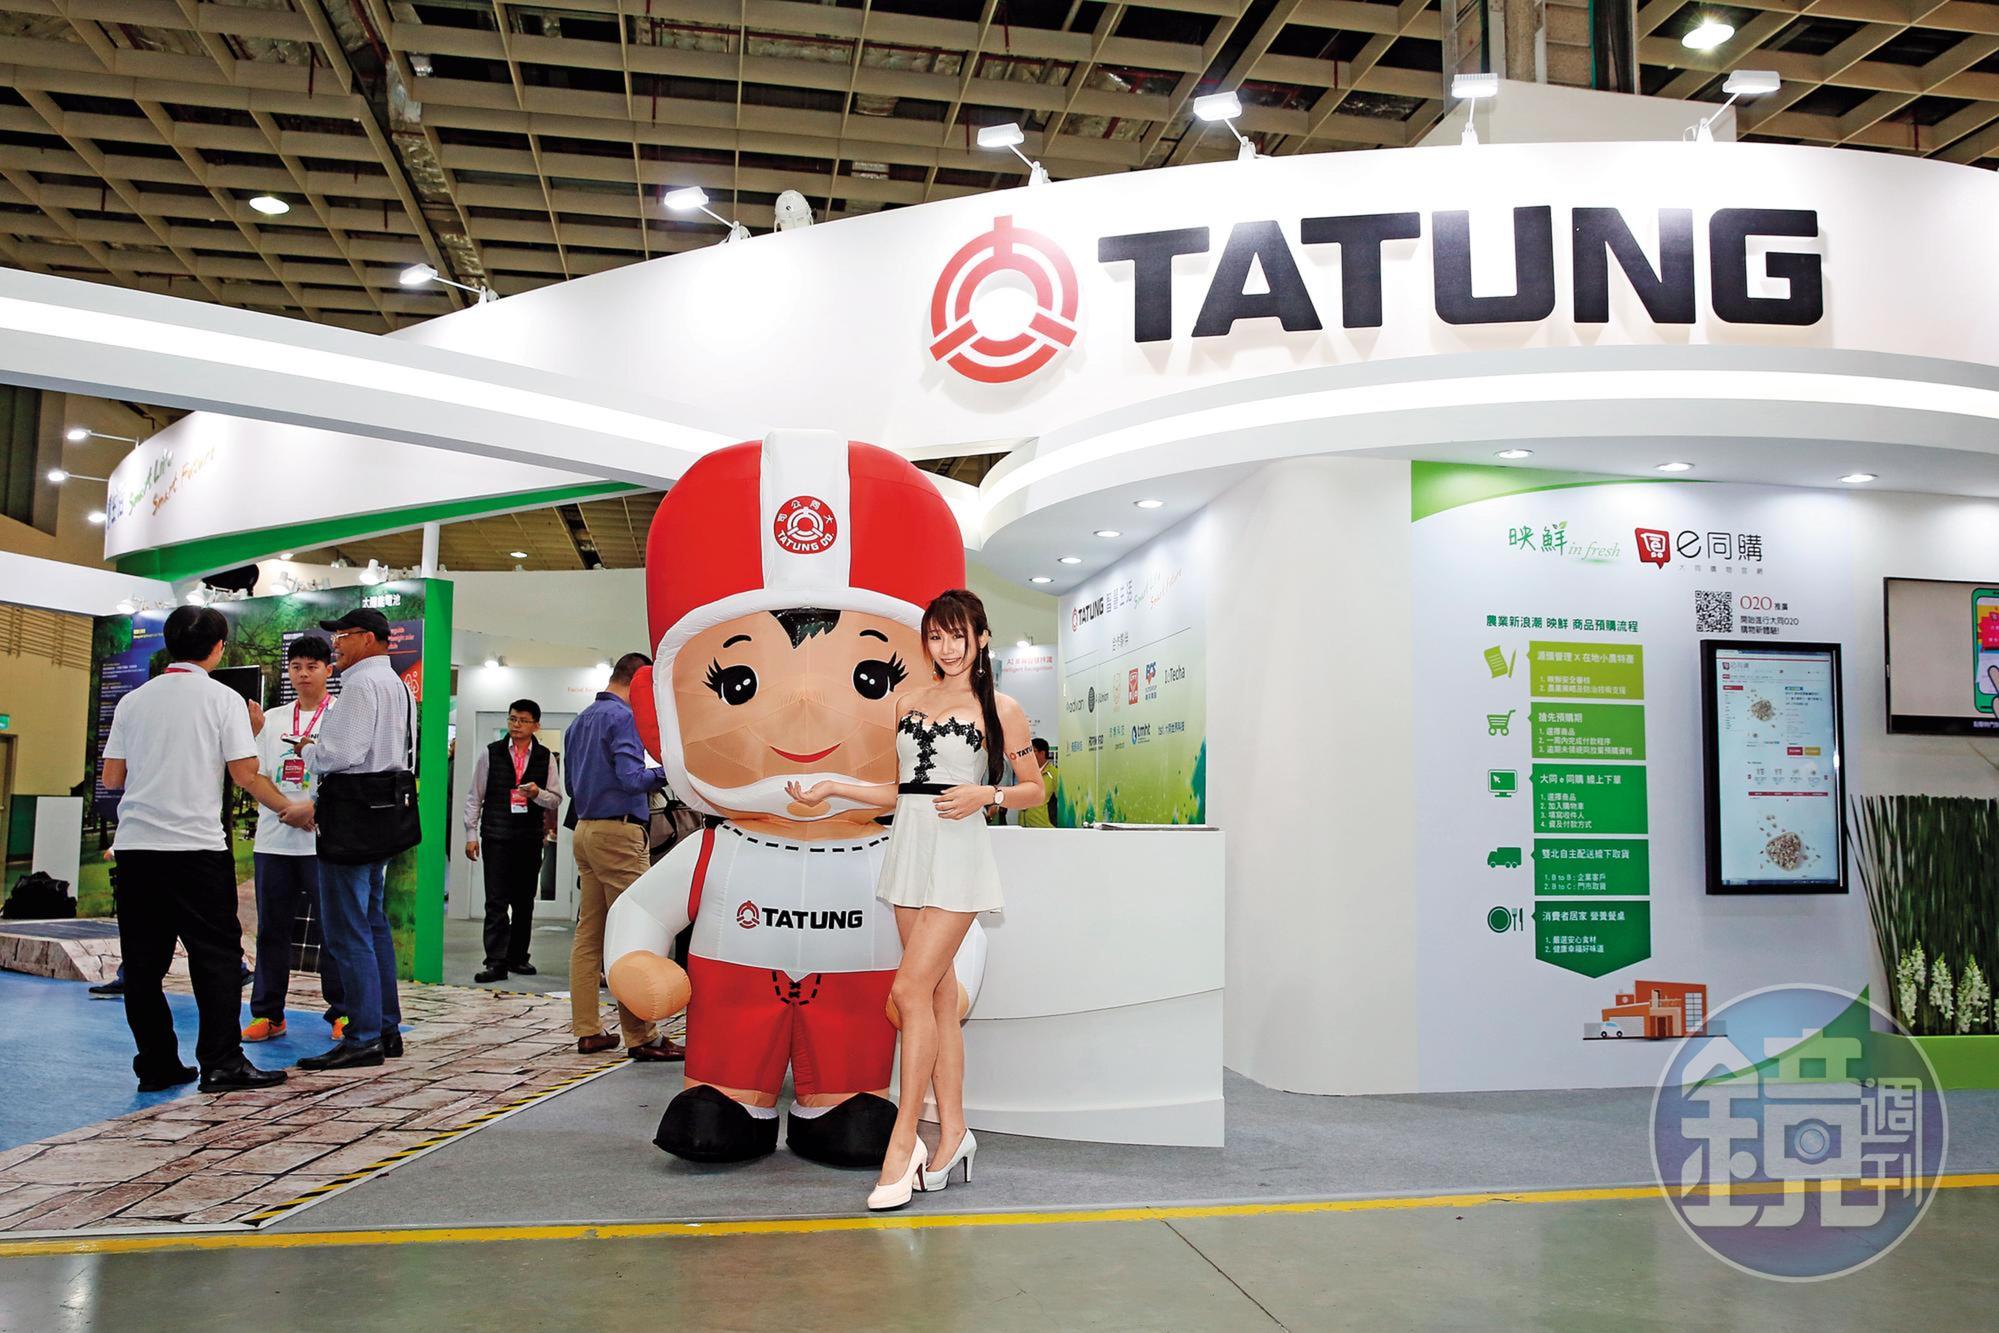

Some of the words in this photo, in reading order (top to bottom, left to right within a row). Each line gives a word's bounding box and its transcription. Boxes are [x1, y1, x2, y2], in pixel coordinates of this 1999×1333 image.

[1097, 205, 1824, 343] TATUNG
[778, 530, 819, 551] TATUNG
[1508, 523, 1568, 557] 映鮮
[1568, 541, 1582, 555] in
[1582, 541, 1621, 560] fresh
[1078, 597, 1104, 626] TATUNG
[1486, 615, 1543, 628] 農業新浪潮
[1546, 617, 1568, 630] 映鮮
[1572, 618, 1639, 633] 商品預購流程
[1540, 774, 1557, 784] 大同
[1566, 774, 1584, 784] 同購
[1587, 775, 1621, 784] 線上下單
[1547, 793, 1576, 801] 選擇商品
[1548, 802, 1584, 810] 加入購物車
[1577, 873, 1606, 881] 企業客戶
[762, 907, 863, 930] TATUNG
[1542, 911, 1587, 921] 消費者居家
[1590, 911, 1625, 921] 營養餐桌
